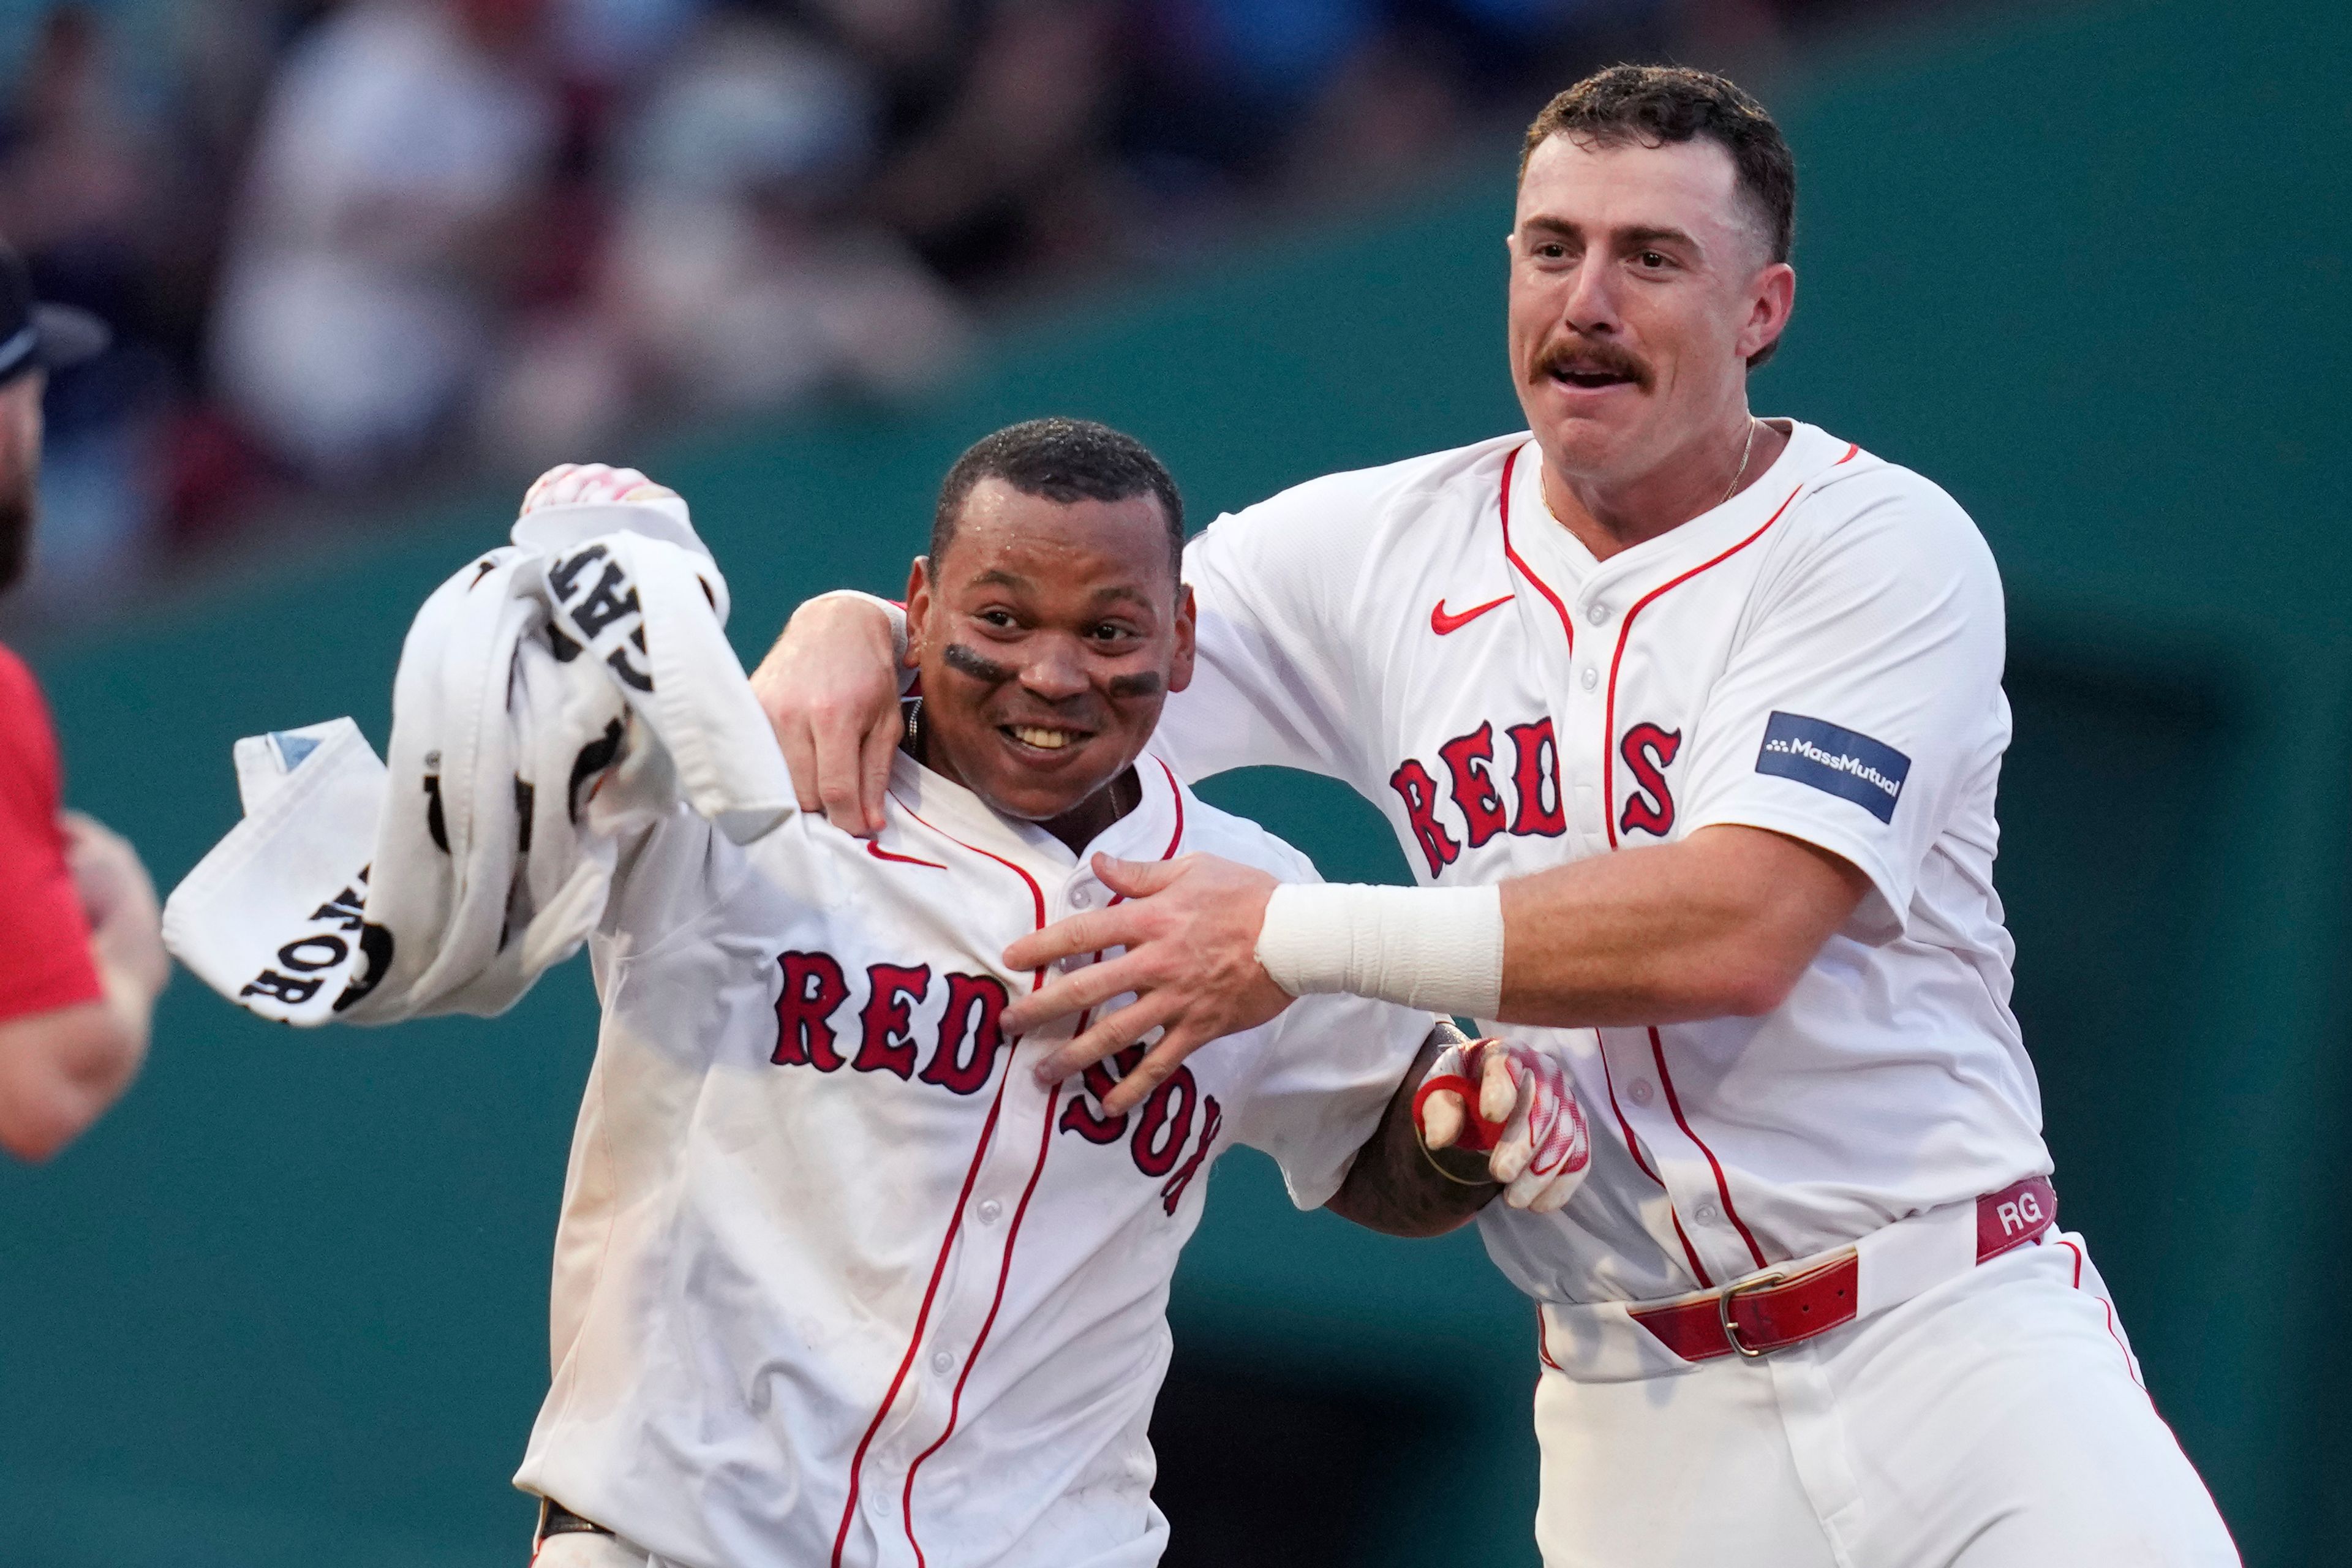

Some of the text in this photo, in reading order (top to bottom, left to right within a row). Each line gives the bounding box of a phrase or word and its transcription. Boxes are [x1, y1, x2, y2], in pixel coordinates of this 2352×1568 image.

[1390, 715, 1567, 880] RED
[1790, 737, 1900, 797] MassMutual
[770, 949, 1223, 1217] RED SOX
[1996, 1192, 2044, 1237] RG
